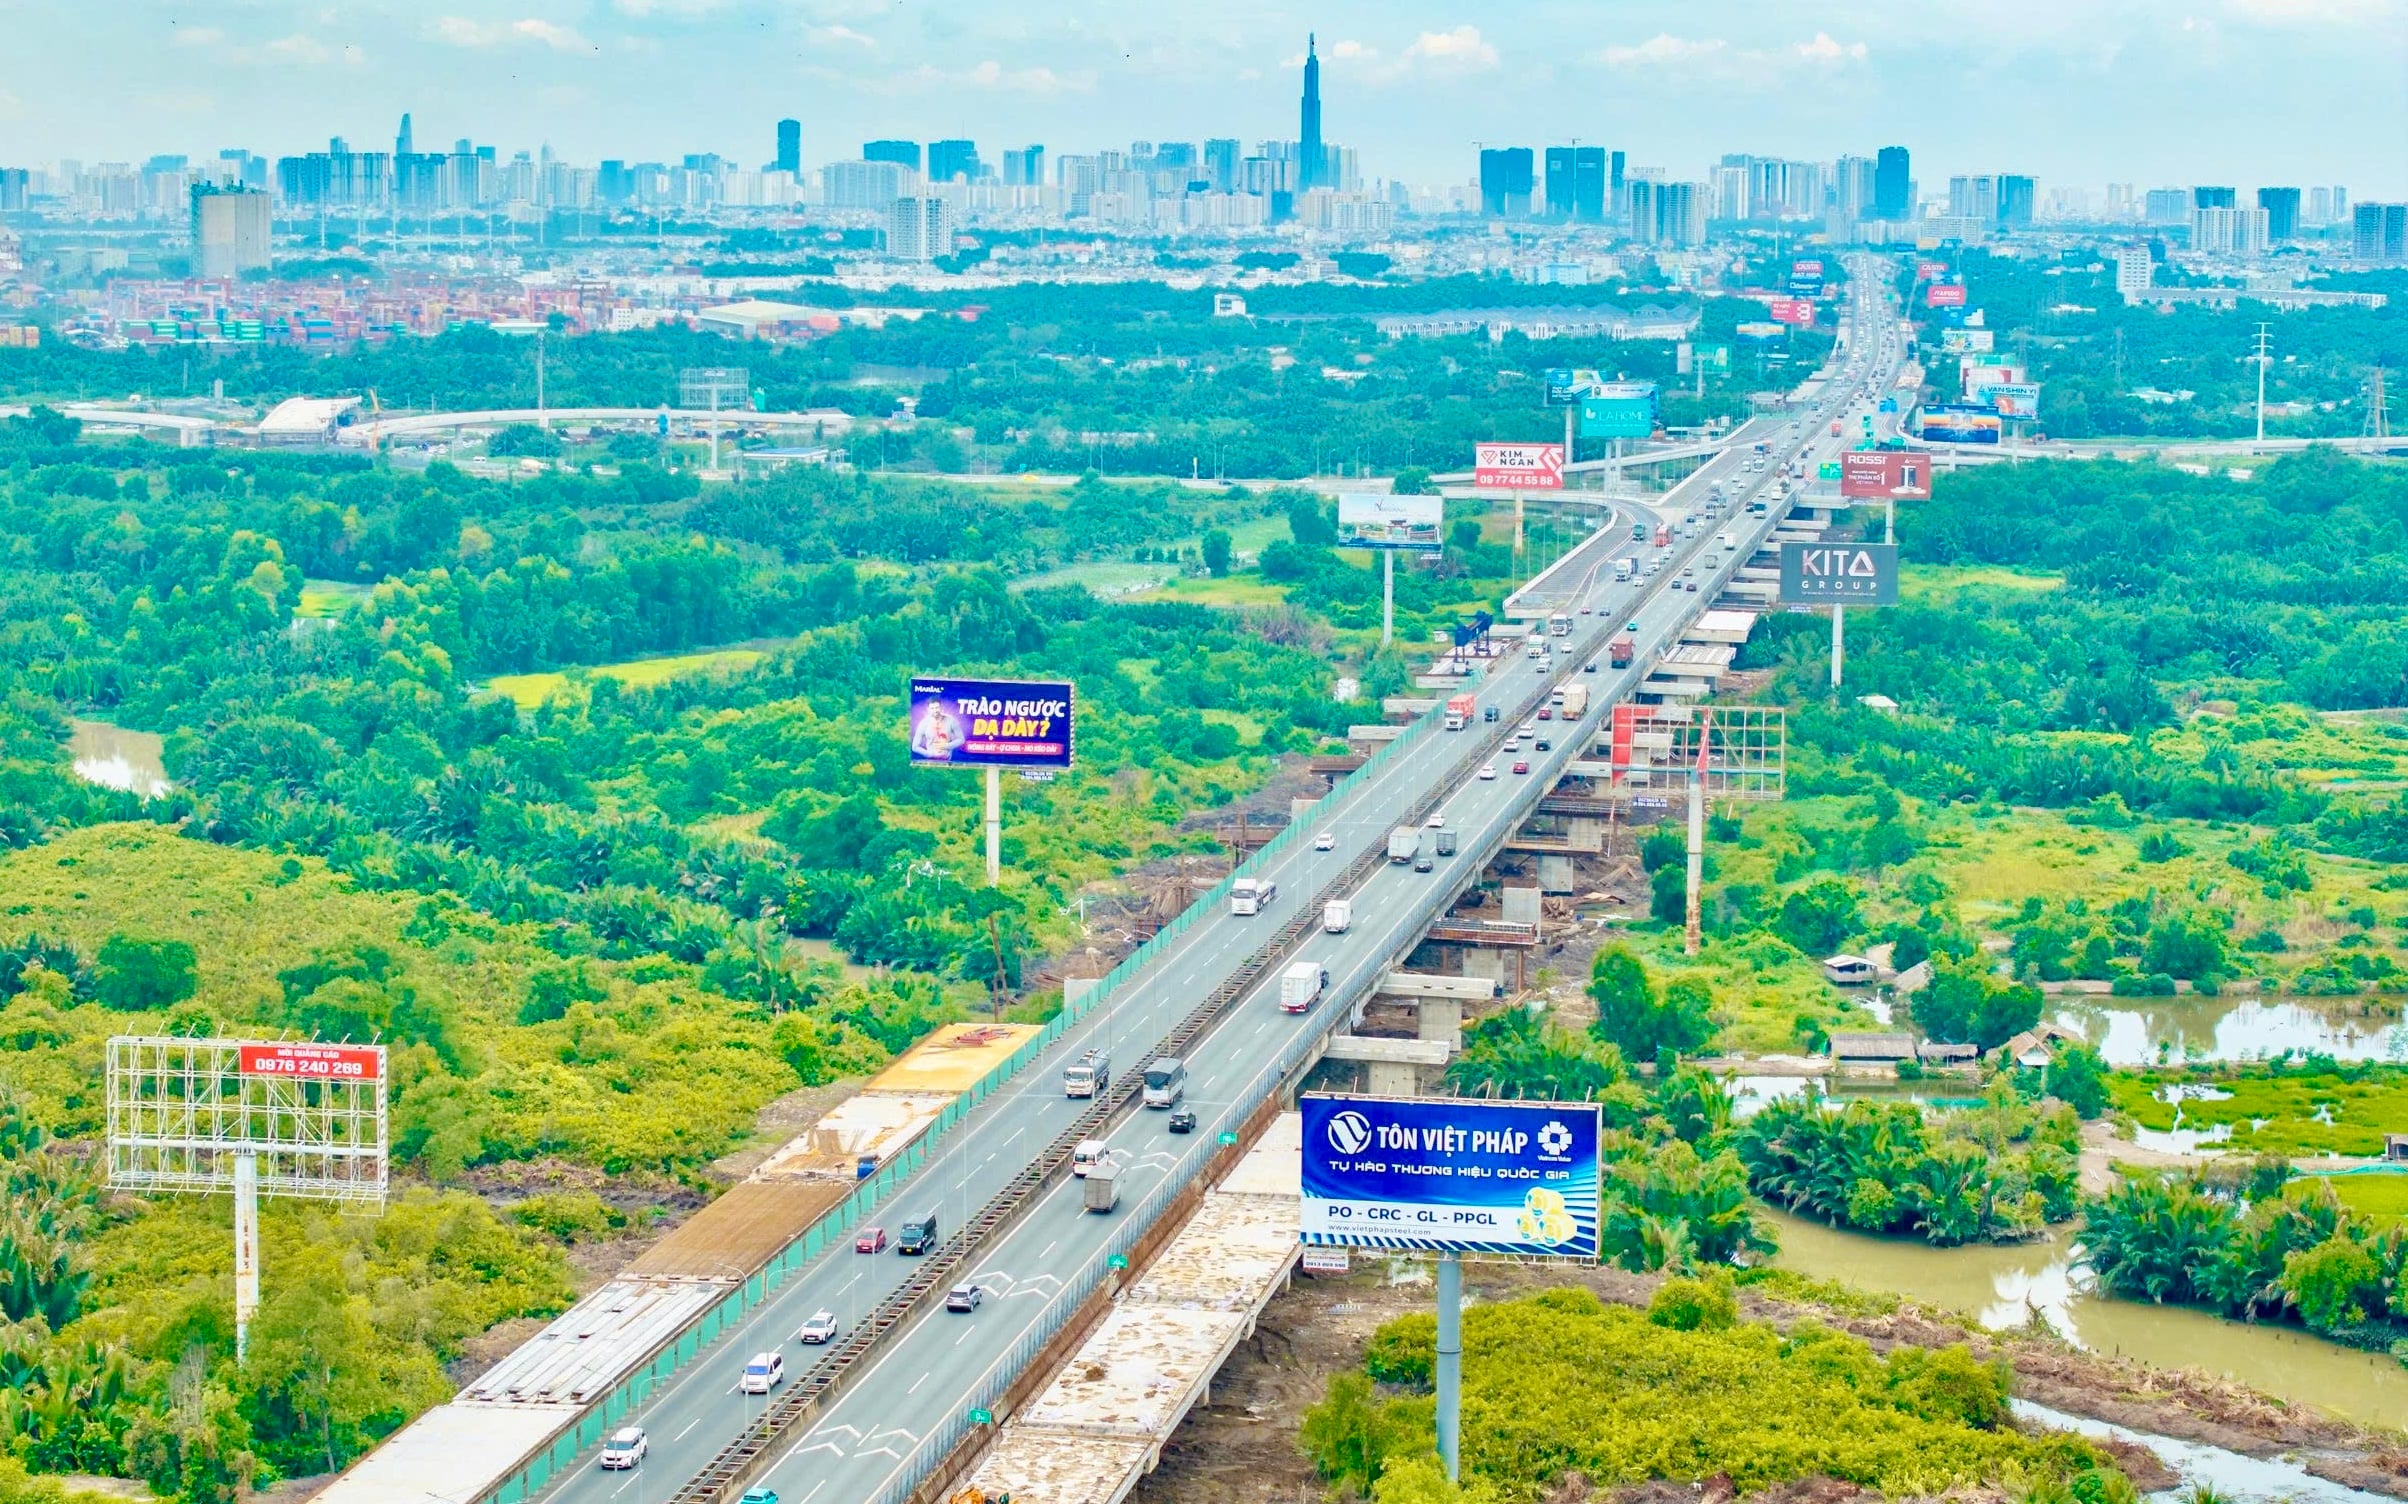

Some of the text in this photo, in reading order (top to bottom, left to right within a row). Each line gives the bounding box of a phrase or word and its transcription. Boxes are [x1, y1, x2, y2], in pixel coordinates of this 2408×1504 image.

[1500, 450, 1522, 458] KIM
[1848, 455, 1886, 465] ROSSI
[1802, 549, 1875, 577] KITA
[1801, 580, 1877, 590] GROUP
[957, 696, 1067, 721] TRÀO NGƯỢC
[972, 718, 999, 740] DẠ
[255, 1058, 362, 1074] 0976 240 269
[1376, 1123, 1529, 1157] TÔN VIỆT PHÁP
[1355, 1160, 1386, 1172] HÀO
[1457, 1166, 1492, 1178] HIỆU
[1545, 1170, 1570, 1180] GIA
[1328, 1205, 1352, 1218] PO
[1367, 1208, 1401, 1220] CRC
[1417, 1210, 1438, 1222] GL
[1453, 1212, 1497, 1225] PPGL
[1328, 1224, 1432, 1236] www.vietphapsteel.com
